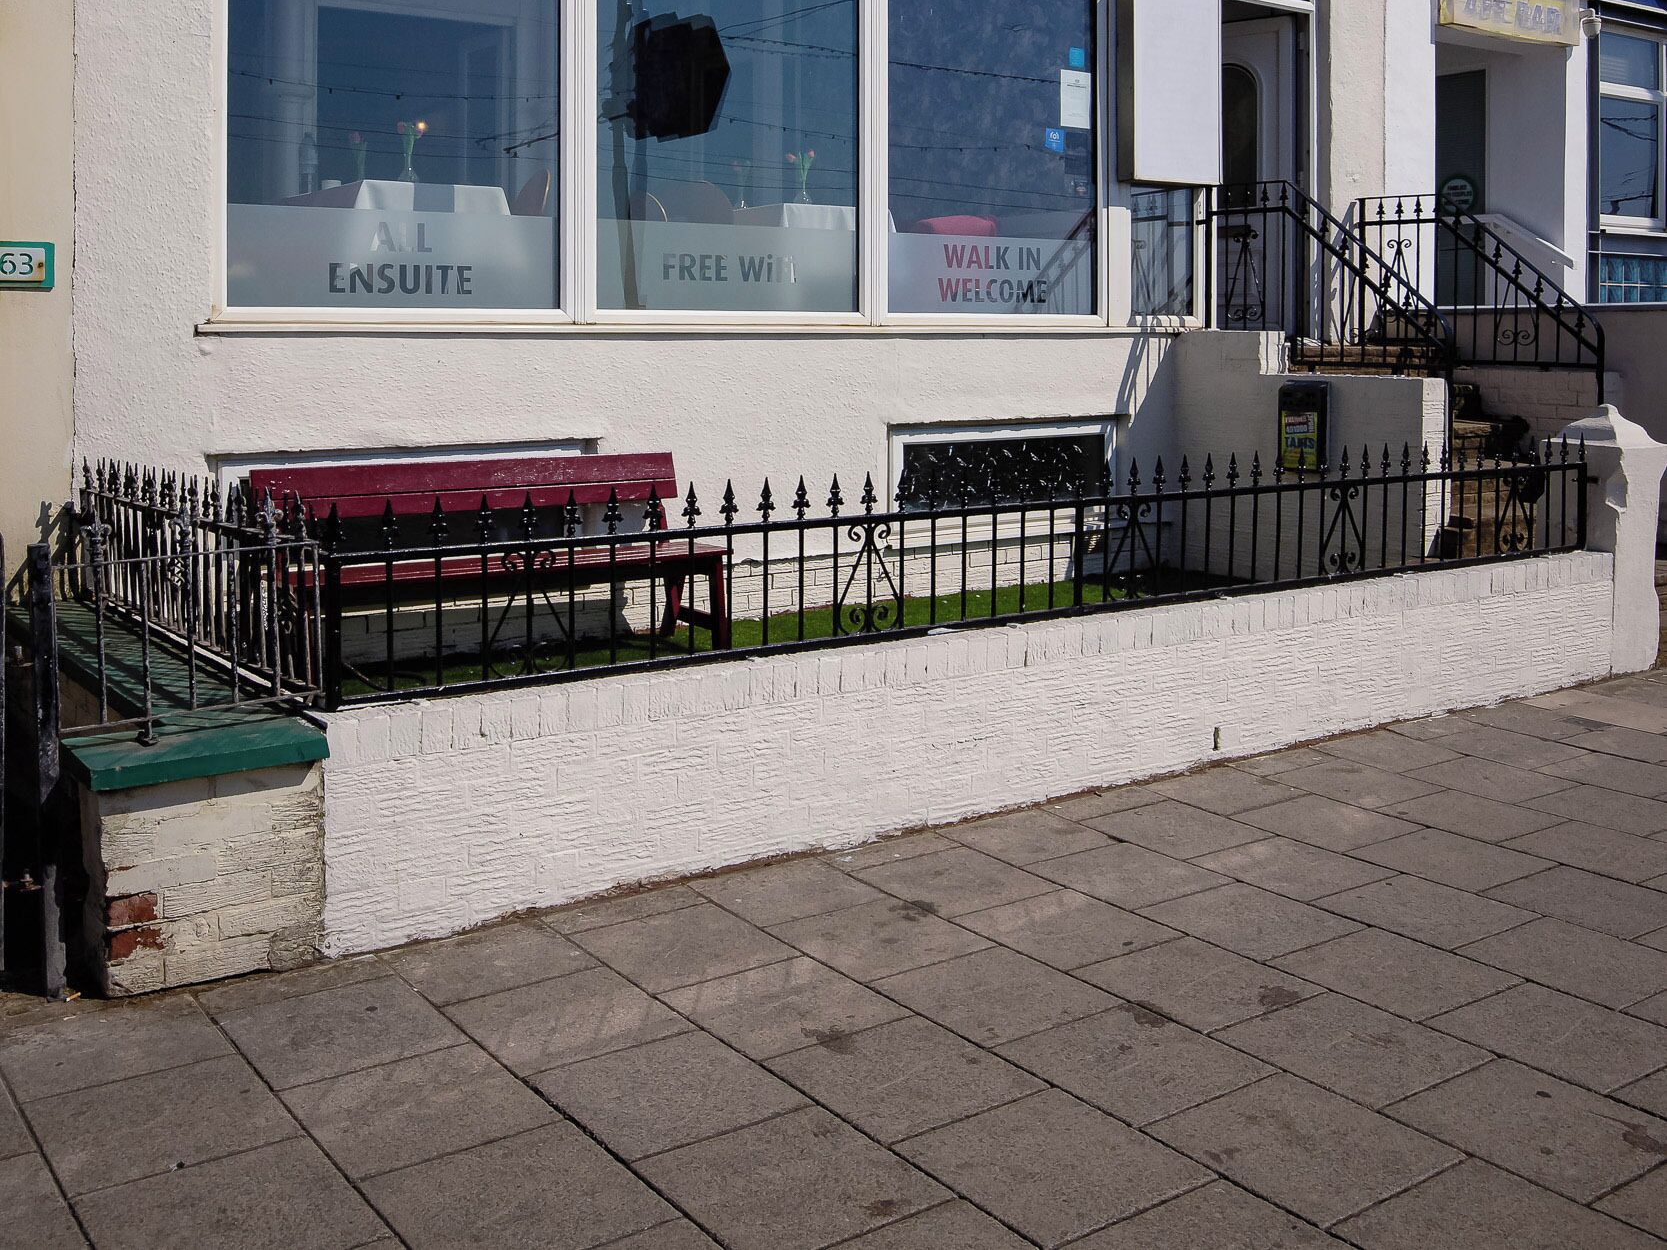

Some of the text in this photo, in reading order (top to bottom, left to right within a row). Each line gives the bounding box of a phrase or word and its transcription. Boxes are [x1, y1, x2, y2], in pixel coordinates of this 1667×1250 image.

[1515, 0, 1562, 36] BAR
[370, 221, 433, 253] ALL
[0, 253, 34, 275] 63
[662, 253, 728, 282] FREE
[943, 244, 1041, 271] WALK IN
[328, 262, 472, 295] ENSUITE
[938, 277, 1047, 304] WELCOME
